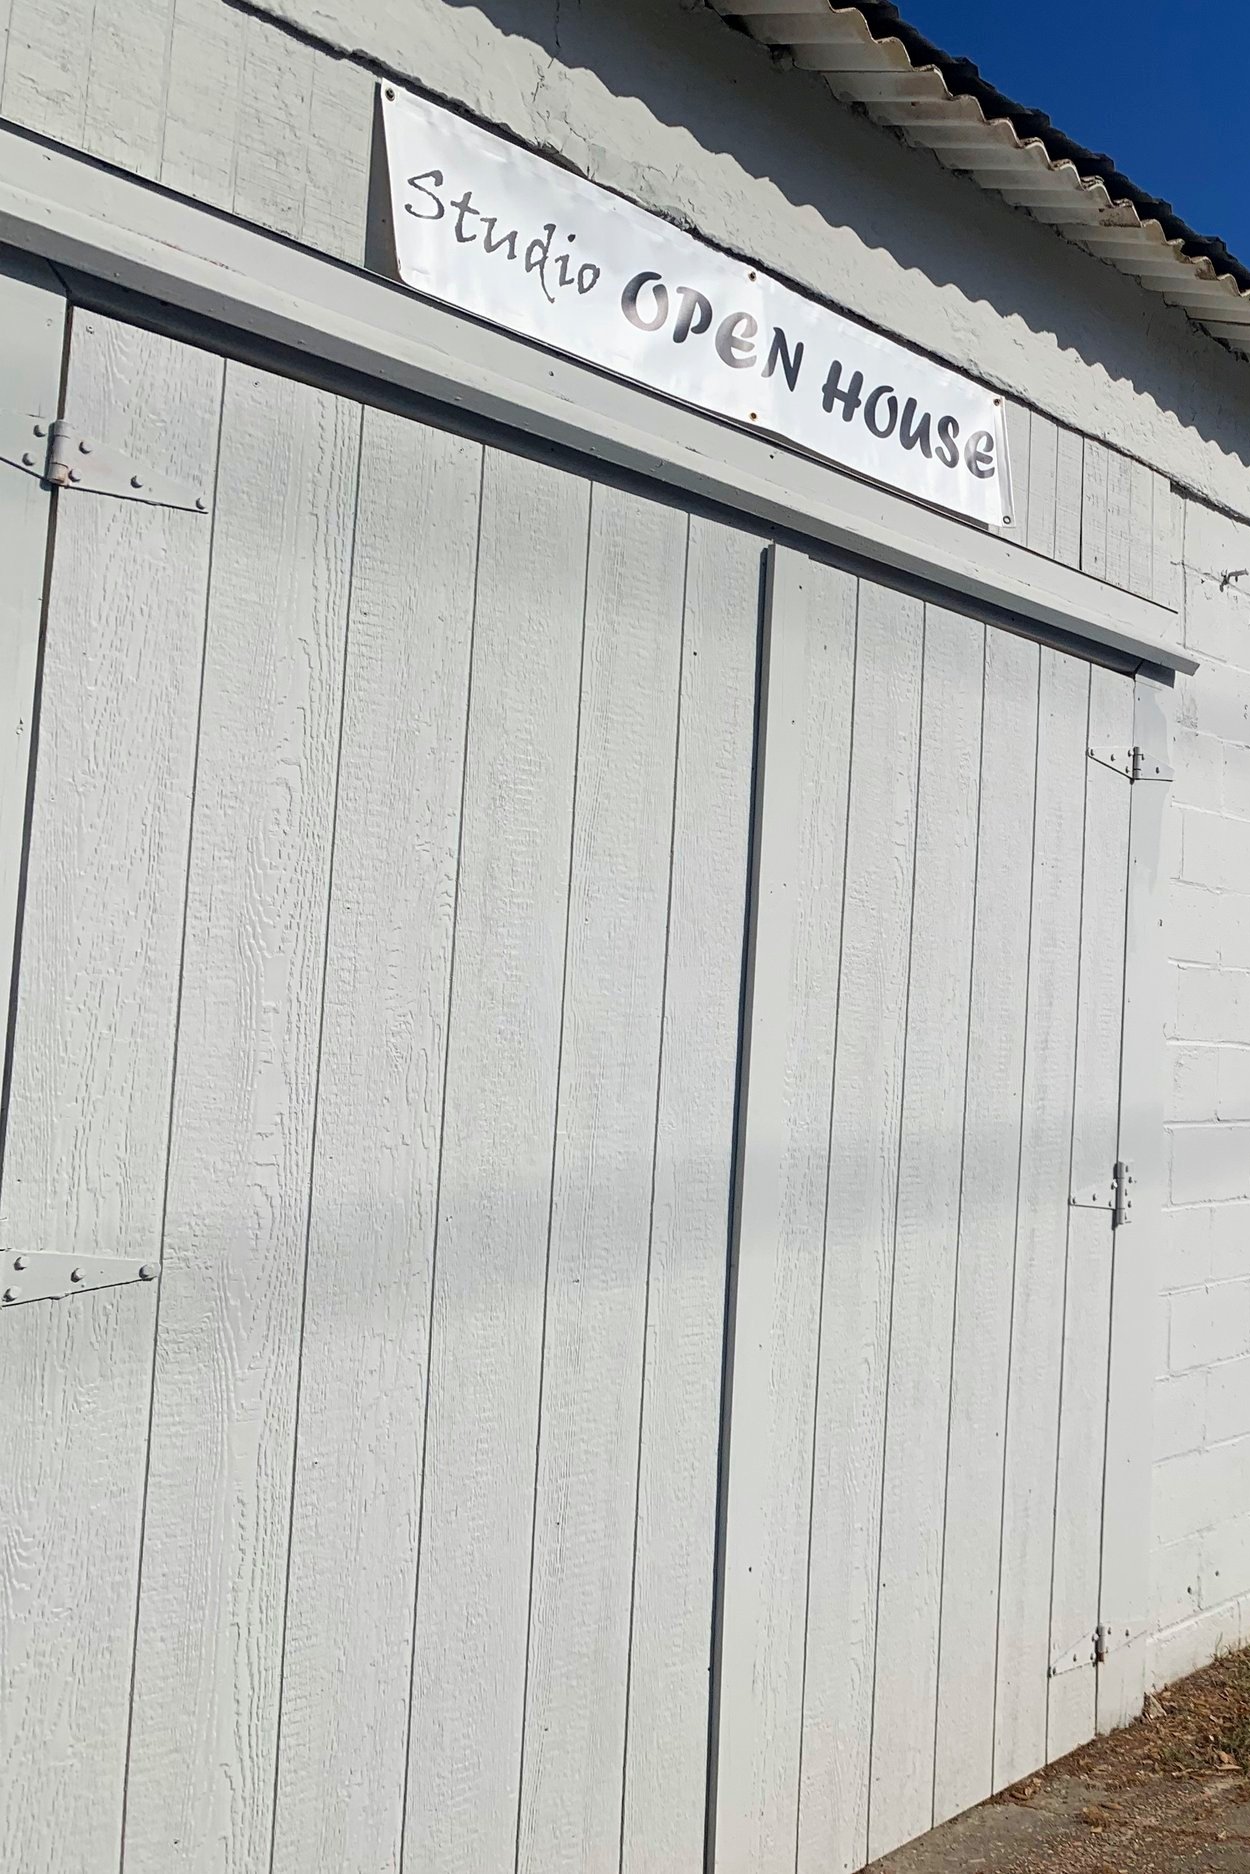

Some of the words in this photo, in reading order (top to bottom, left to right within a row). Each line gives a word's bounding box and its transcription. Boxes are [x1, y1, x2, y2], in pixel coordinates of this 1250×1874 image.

[404, 170, 601, 303] Studio
[620, 271, 805, 392] OPEN
[822, 360, 996, 480] HOUSE
